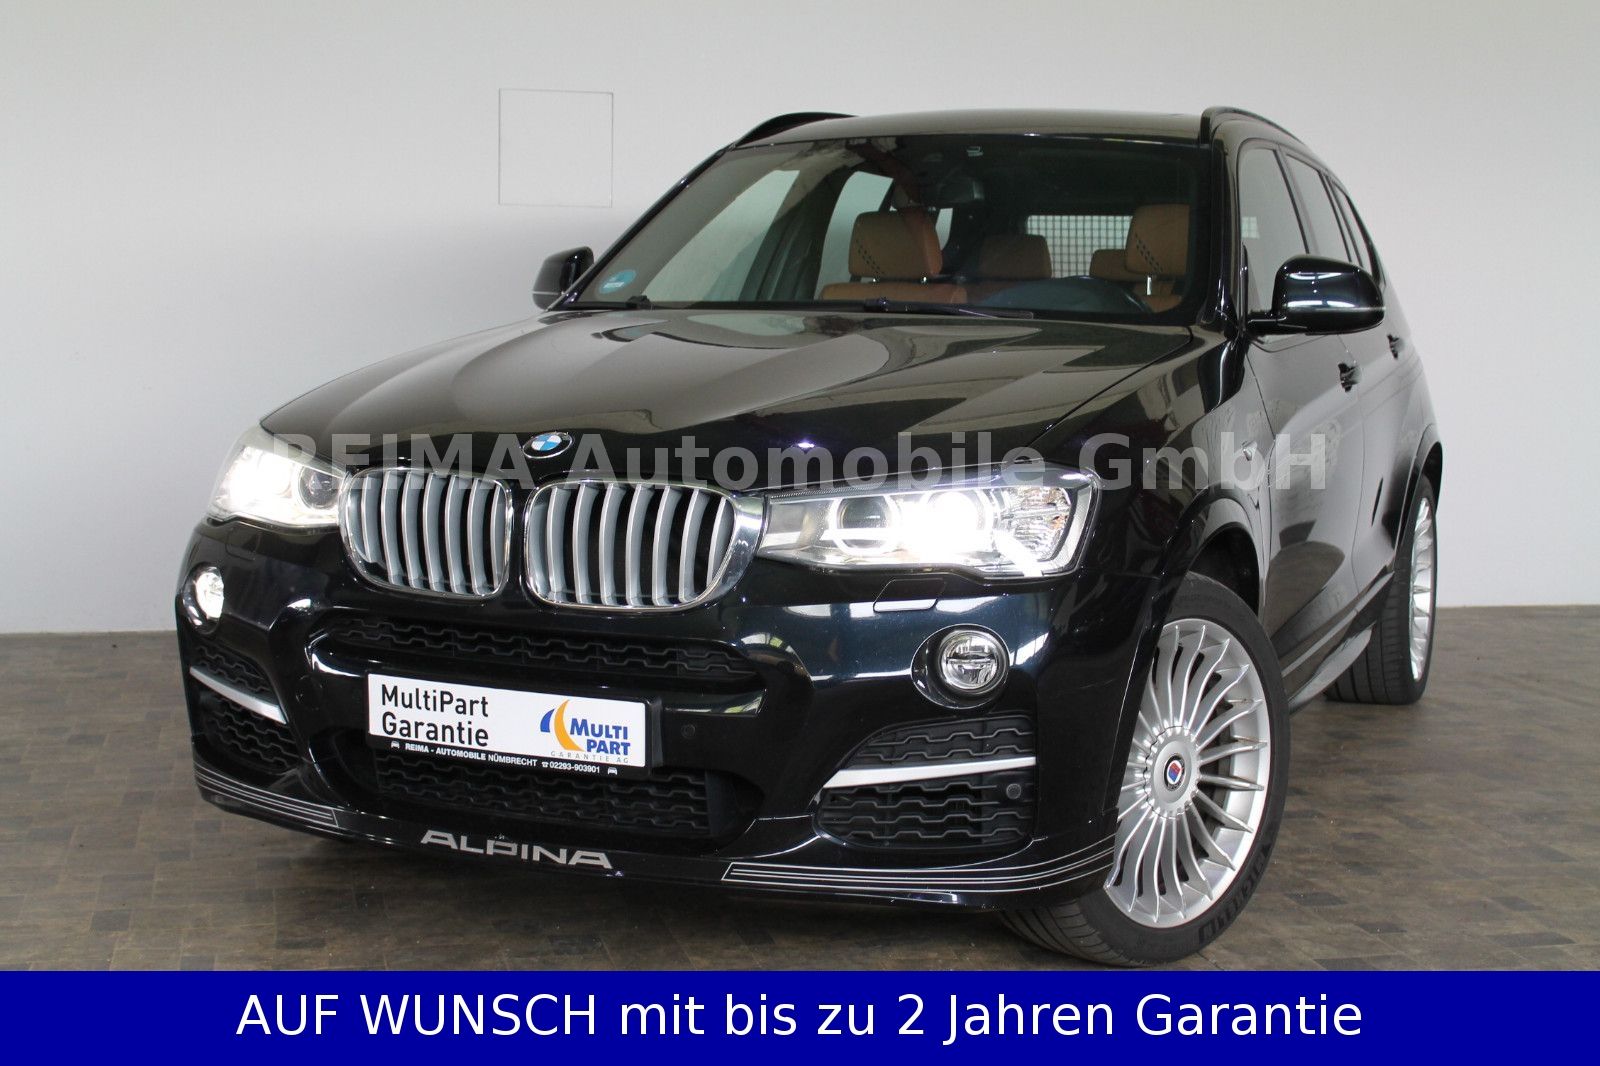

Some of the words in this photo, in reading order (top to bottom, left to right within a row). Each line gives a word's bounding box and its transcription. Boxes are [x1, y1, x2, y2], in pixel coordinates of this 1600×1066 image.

[381, 684, 489, 717] MultiPart
[382, 711, 489, 747] Garantie
[405, 743, 430, 753] REIMA
[435, 747, 487, 761] AUTOMOBILE
[487, 753, 538, 767] NÜMBRECHT
[549, 760, 601, 774] 02293-903901
[550, 750, 610, 763] GARANTIE
[586, 738, 631, 756] PART
[420, 829, 613, 870] ALPINA
